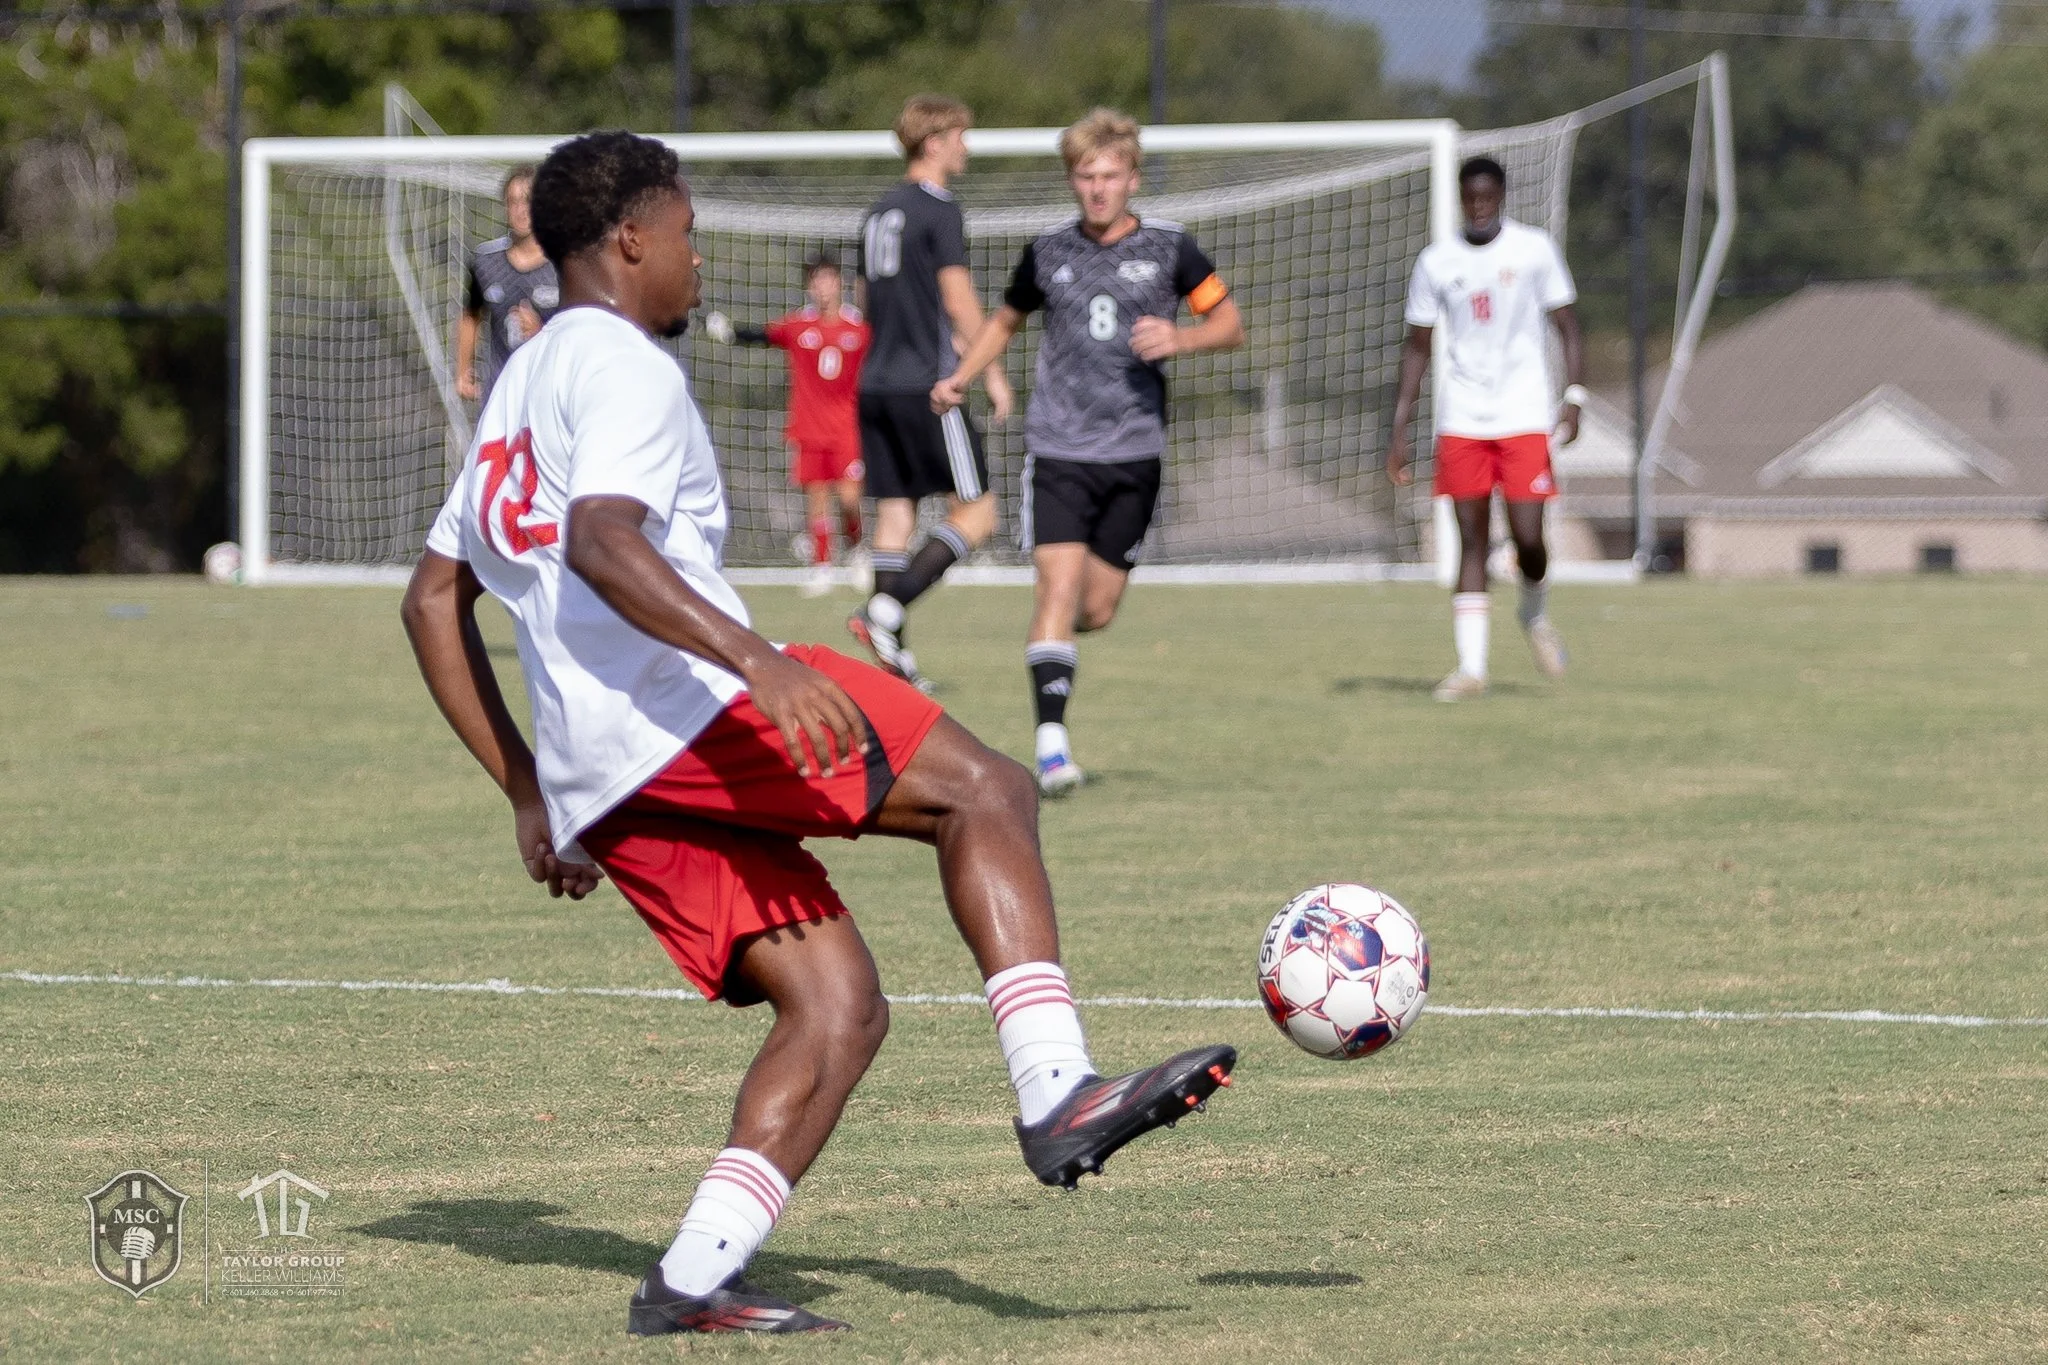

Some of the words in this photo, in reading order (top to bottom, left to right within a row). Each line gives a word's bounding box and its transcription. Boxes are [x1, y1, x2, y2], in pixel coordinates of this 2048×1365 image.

[864, 207, 905, 281] 16
[1089, 294, 1118, 341] 8
[818, 345, 843, 380] 0
[1261, 888, 1319, 963] SELE
